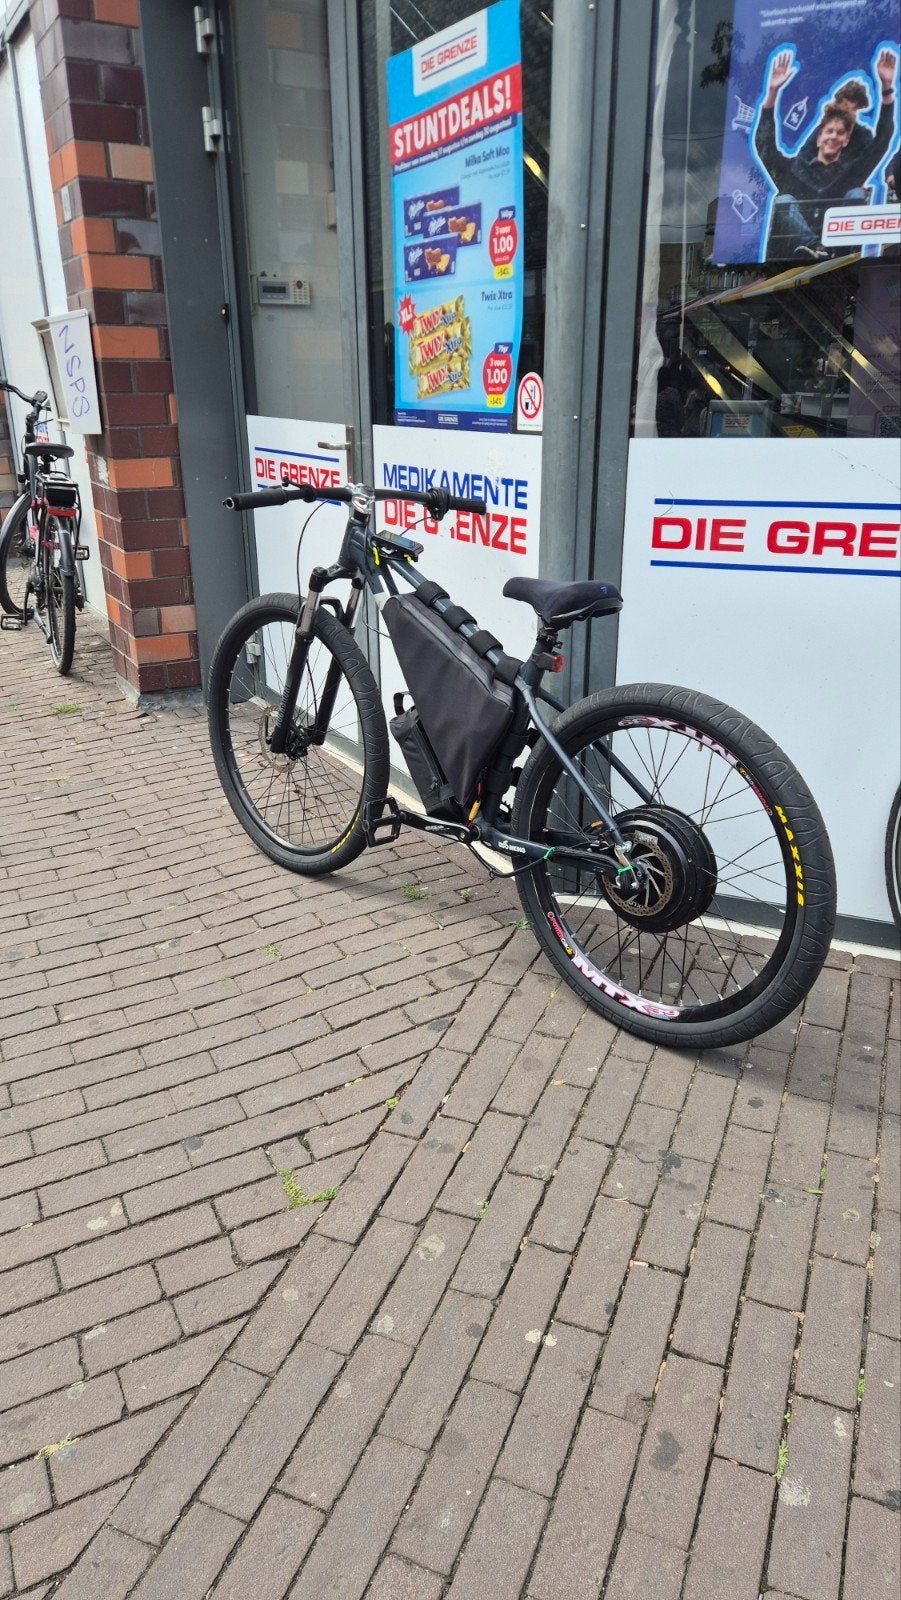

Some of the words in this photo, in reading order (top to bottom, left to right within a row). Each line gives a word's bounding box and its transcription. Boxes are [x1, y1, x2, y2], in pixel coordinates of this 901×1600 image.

[421, 56, 435, 74] DIE
[437, 34, 478, 65] GRENZE
[394, 75, 512, 158] STUNTDEALS!
[482, 149, 495, 162] Soft
[827, 220, 855, 232] DIE
[493, 235, 514, 254] 1.00
[481, 290, 496, 302] Twix
[498, 289, 512, 300] Xtra
[400, 304, 413, 323] XL!
[58, 324, 90, 418] NSPS
[487, 368, 508, 384] 1.00
[255, 457, 276, 480] DIE
[280, 461, 340, 488] GRENZE
[383, 463, 528, 510] MEDIKAMENTE
[384, 499, 416, 530] DIE
[423, 503, 527, 555] GENZE
[651, 516, 747, 553] DIE
[572, 955, 650, 1016] MTX
